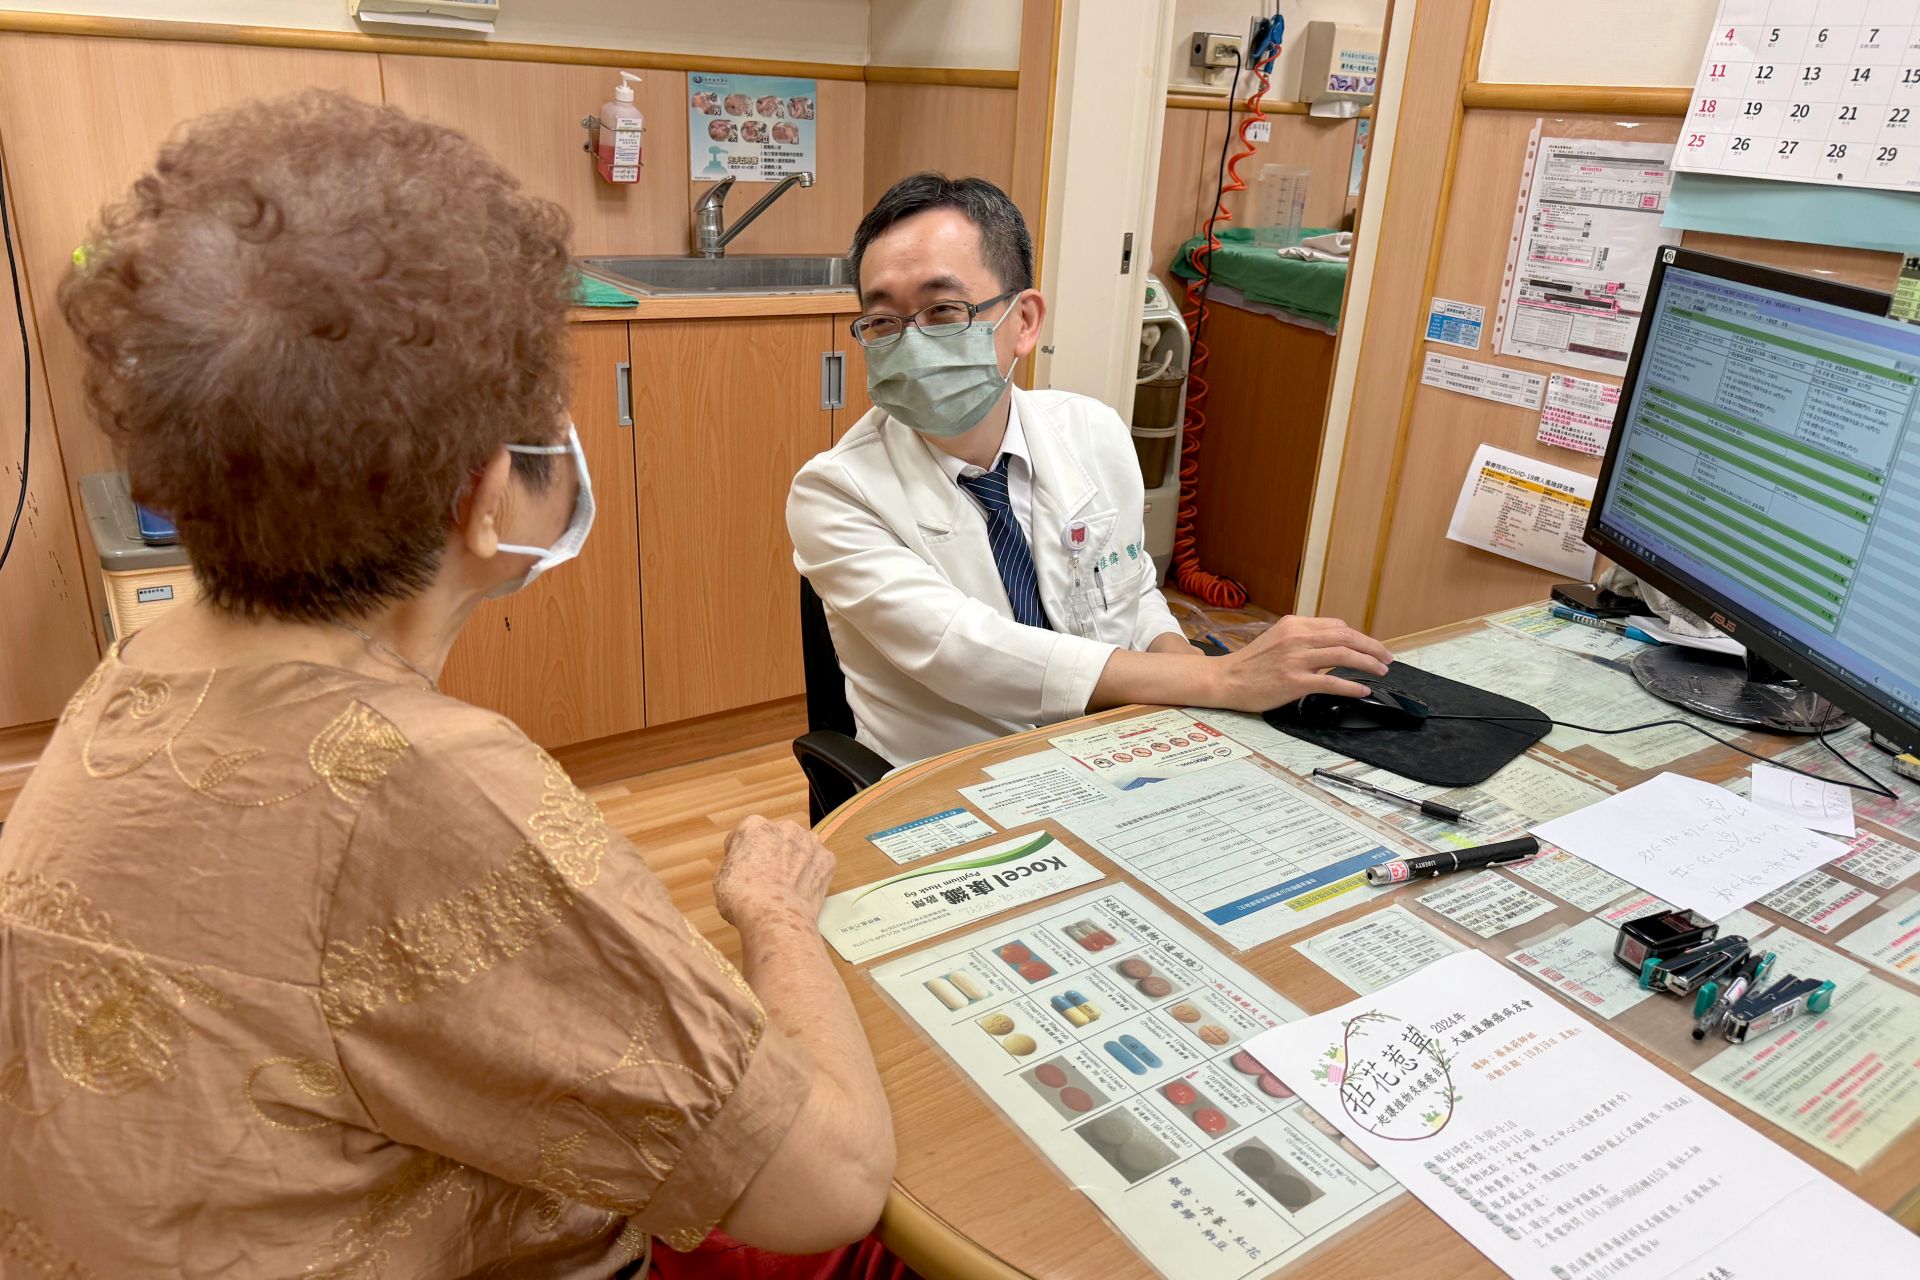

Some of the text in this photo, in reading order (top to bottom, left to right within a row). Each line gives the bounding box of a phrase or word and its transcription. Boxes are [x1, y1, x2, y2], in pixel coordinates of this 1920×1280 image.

[1725, 28, 1735, 41] 4
[1770, 28, 1780, 42] 5
[1818, 28, 1829, 42] 6
[1869, 28, 1880, 43] 7
[1710, 64, 1726, 78] 11
[1755, 66, 1774, 80] 12
[1802, 67, 1821, 81] 13
[1850, 68, 1871, 82] 14
[1902, 69, 1920, 83] 15
[1699, 100, 1716, 112] 18
[1744, 102, 1762, 116] 19
[1790, 104, 1810, 118] 20
[1838, 106, 1858, 120] 21
[1888, 108, 1910, 123] 22
[1688, 134, 1706, 148] 25
[1732, 137, 1750, 150] 26
[1778, 140, 1799, 154] 27
[1826, 144, 1847, 158] 28
[1876, 147, 1897, 162] 29
[1484, 460, 1576, 494] 醫療院所COVID-19病人風險評估表
[1710, 612, 1736, 633] ASUS
[1415, 860, 1436, 869] LIBERTY
[904, 871, 980, 898] Psyllium Husk 6g
[910, 855, 1068, 910] Kocel 康纖 散劑
[1430, 1012, 1466, 1034] 2024年
[1451, 998, 1534, 1047] 大腸直腸癌病友會
[1342, 1025, 1432, 1114] 拈花惹草
[1472, 1161, 1539, 1198] 活動費用：免費
[1234, 1188, 1257, 1208] 中藥
[1170, 1199, 1230, 1252] 當歸、納豆
